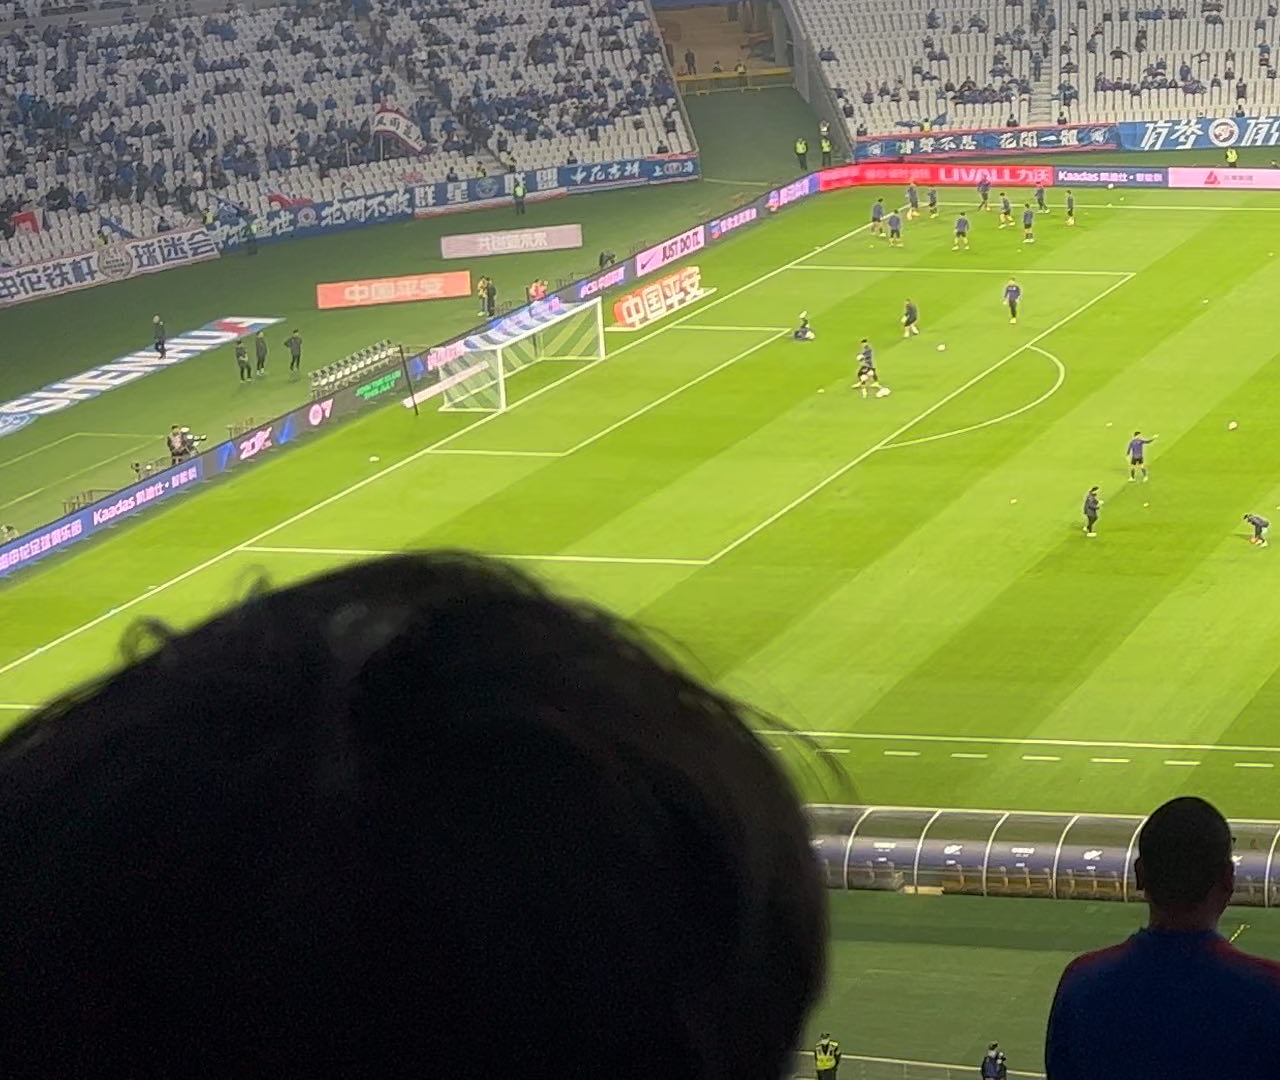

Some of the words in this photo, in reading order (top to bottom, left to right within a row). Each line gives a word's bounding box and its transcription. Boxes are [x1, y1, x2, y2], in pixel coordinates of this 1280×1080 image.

[132, 231, 218, 271] 球迷会
[344, 276, 445, 302] 中国平安
[622, 266, 706, 328] 中国平安
[93, 497, 136, 527] Kaadas
